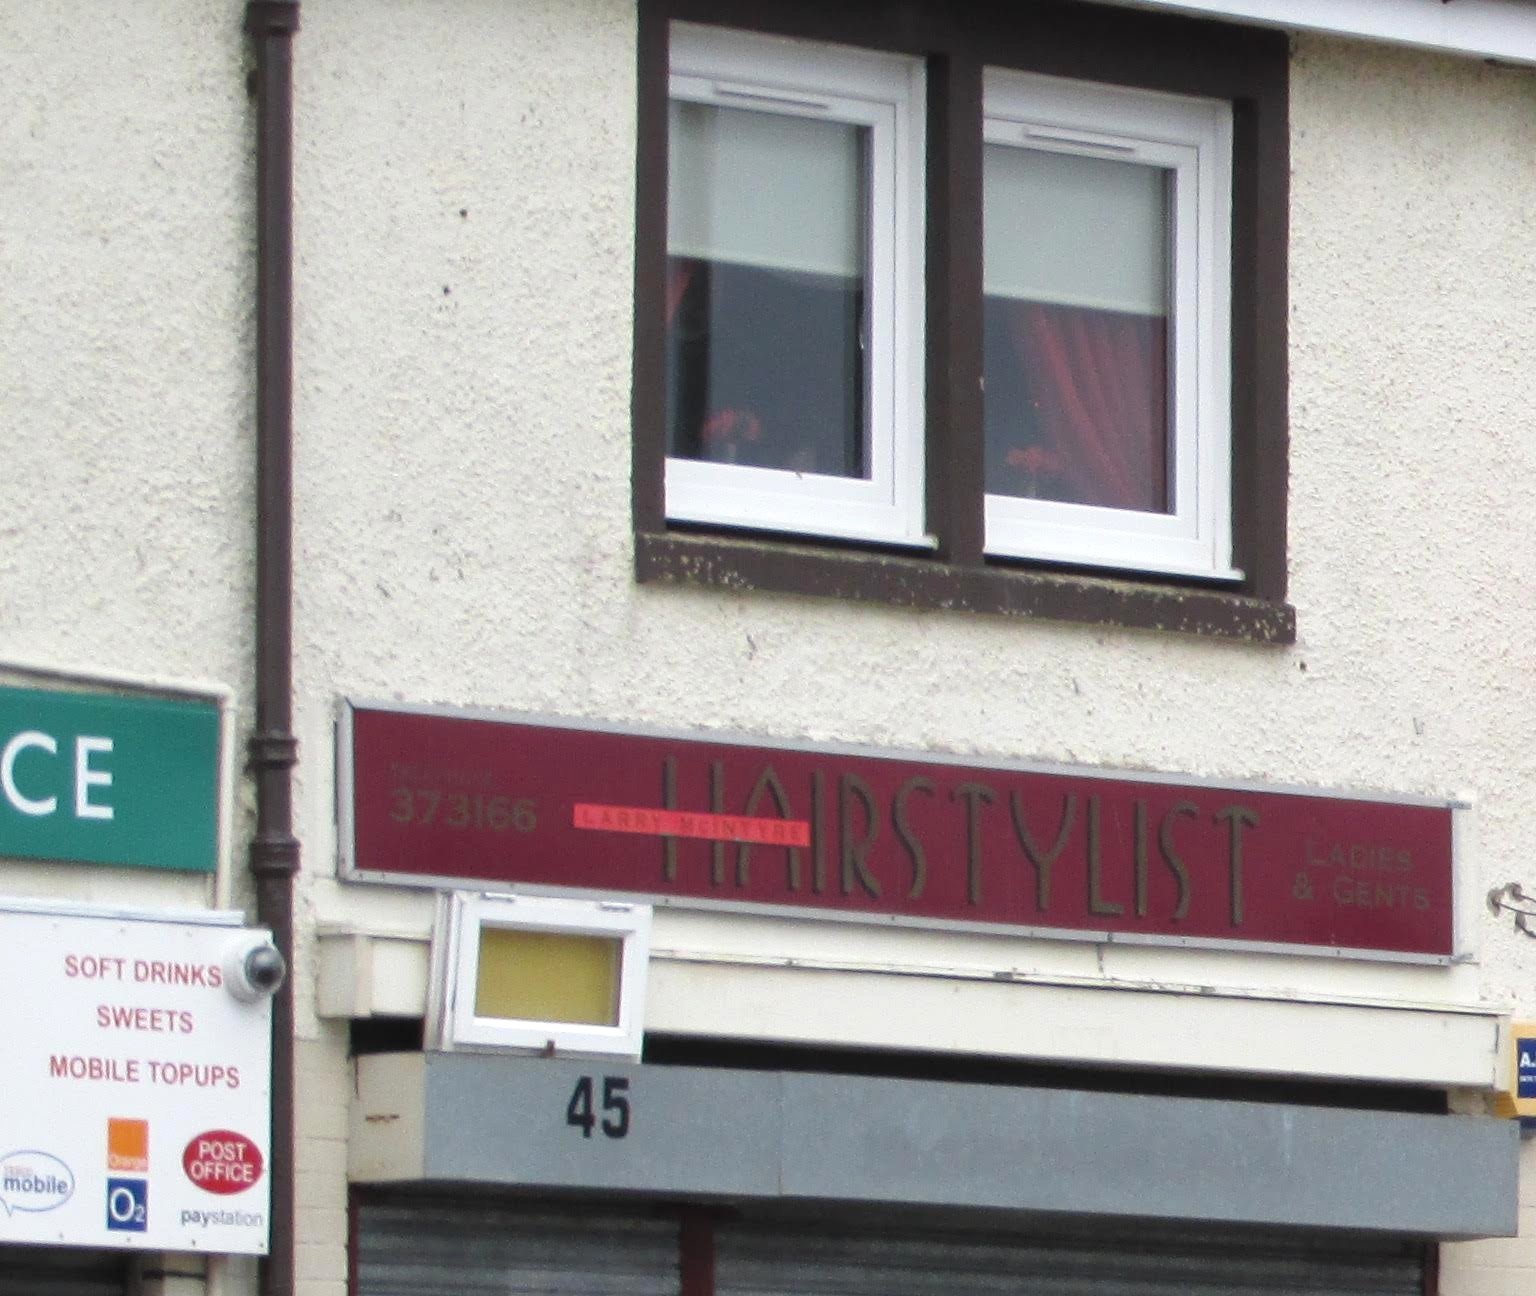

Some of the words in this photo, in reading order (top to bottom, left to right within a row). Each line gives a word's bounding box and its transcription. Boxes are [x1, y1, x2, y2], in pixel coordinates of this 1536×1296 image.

[663, 755, 1261, 926] HAIRSTYLIST
[65, 954, 127, 981] SOFT
[134, 959, 222, 988] DRINKS
[97, 1004, 194, 1035] SWEETS
[50, 1054, 140, 1084] MOBILE
[149, 1061, 241, 1090] TOPUPS
[567, 1075, 630, 1138] 45
[199, 1139, 248, 1162] POST
[4, 1174, 68, 1195] mobile
[190, 1161, 254, 1184] OFFICE
[181, 1207, 263, 1228] paystation
